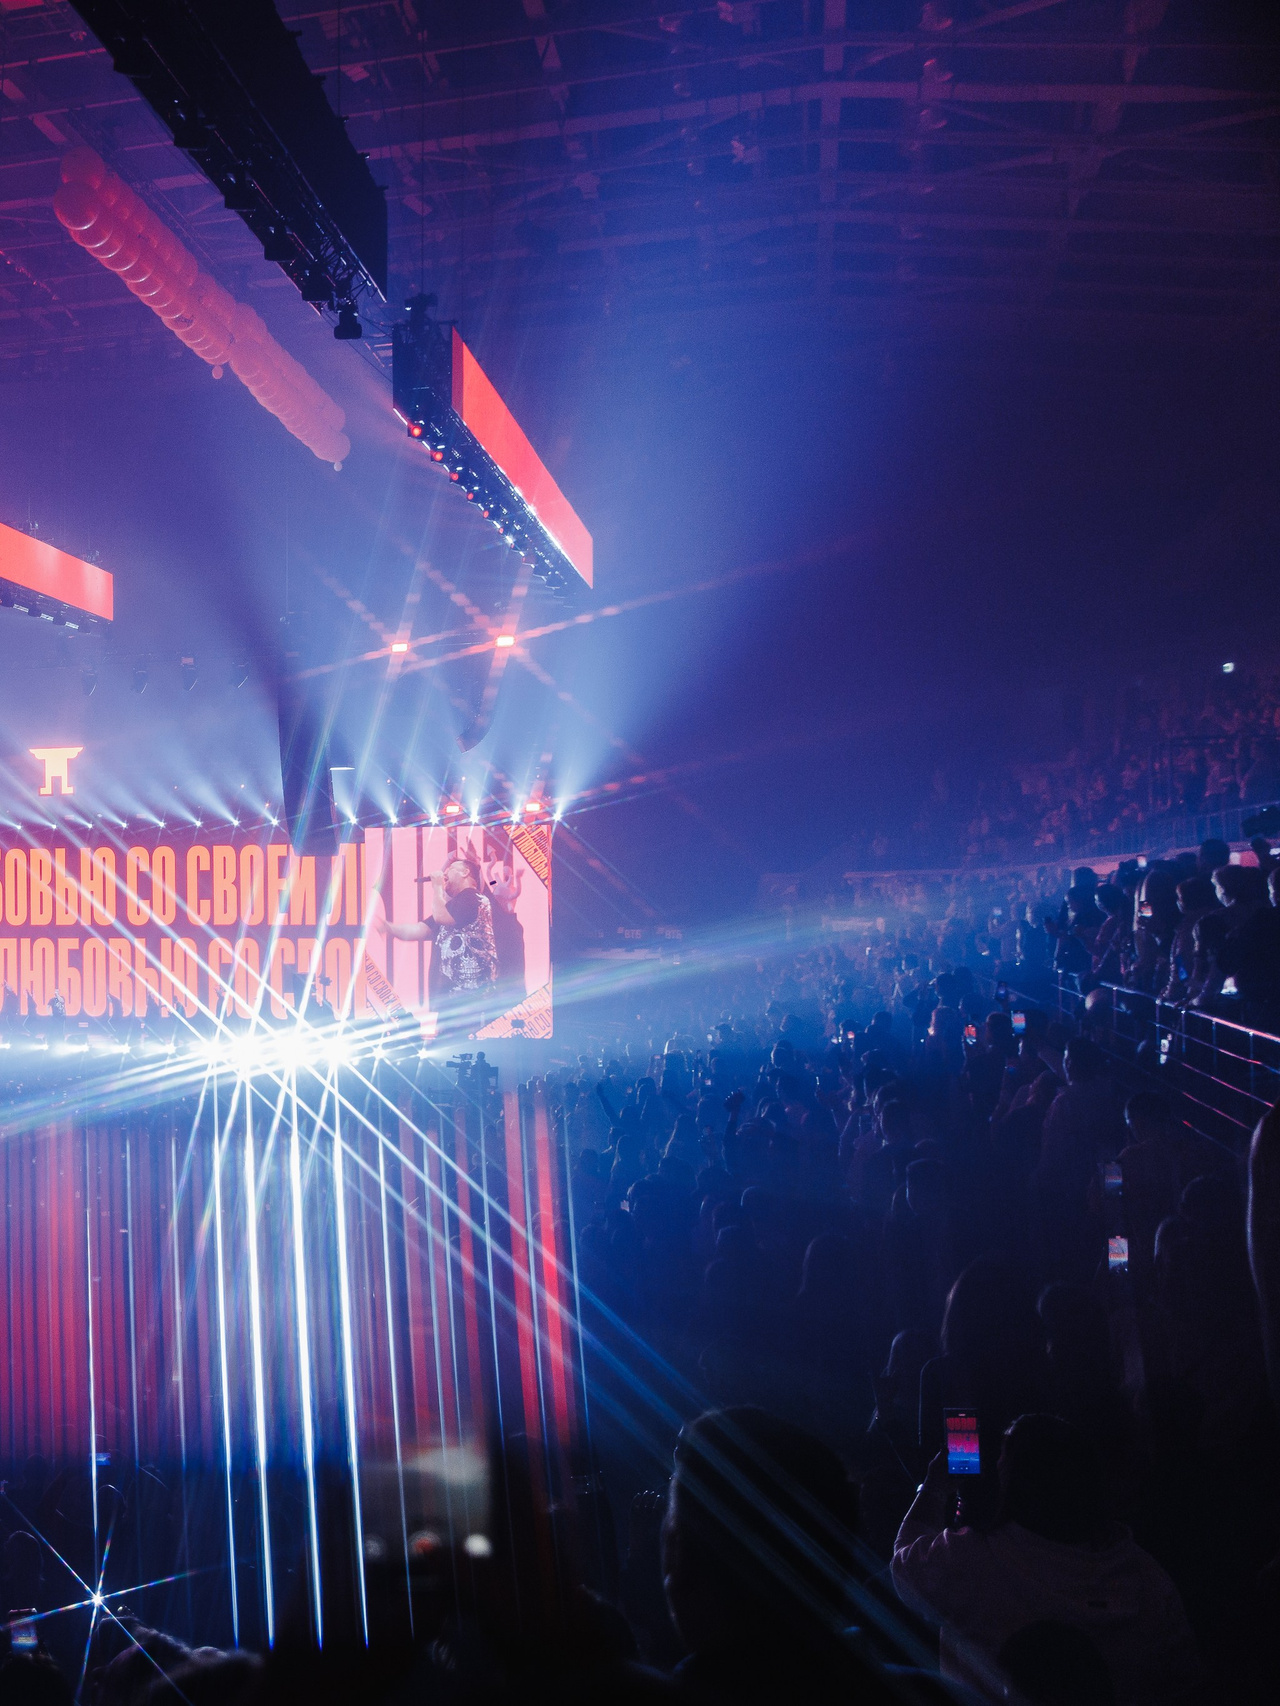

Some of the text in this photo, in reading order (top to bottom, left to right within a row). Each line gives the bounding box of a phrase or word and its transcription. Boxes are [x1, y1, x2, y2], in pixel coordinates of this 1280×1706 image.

[126, 846, 176, 926] СО
[207, 937, 260, 1019] СО
[366, 971, 381, 986] СО
